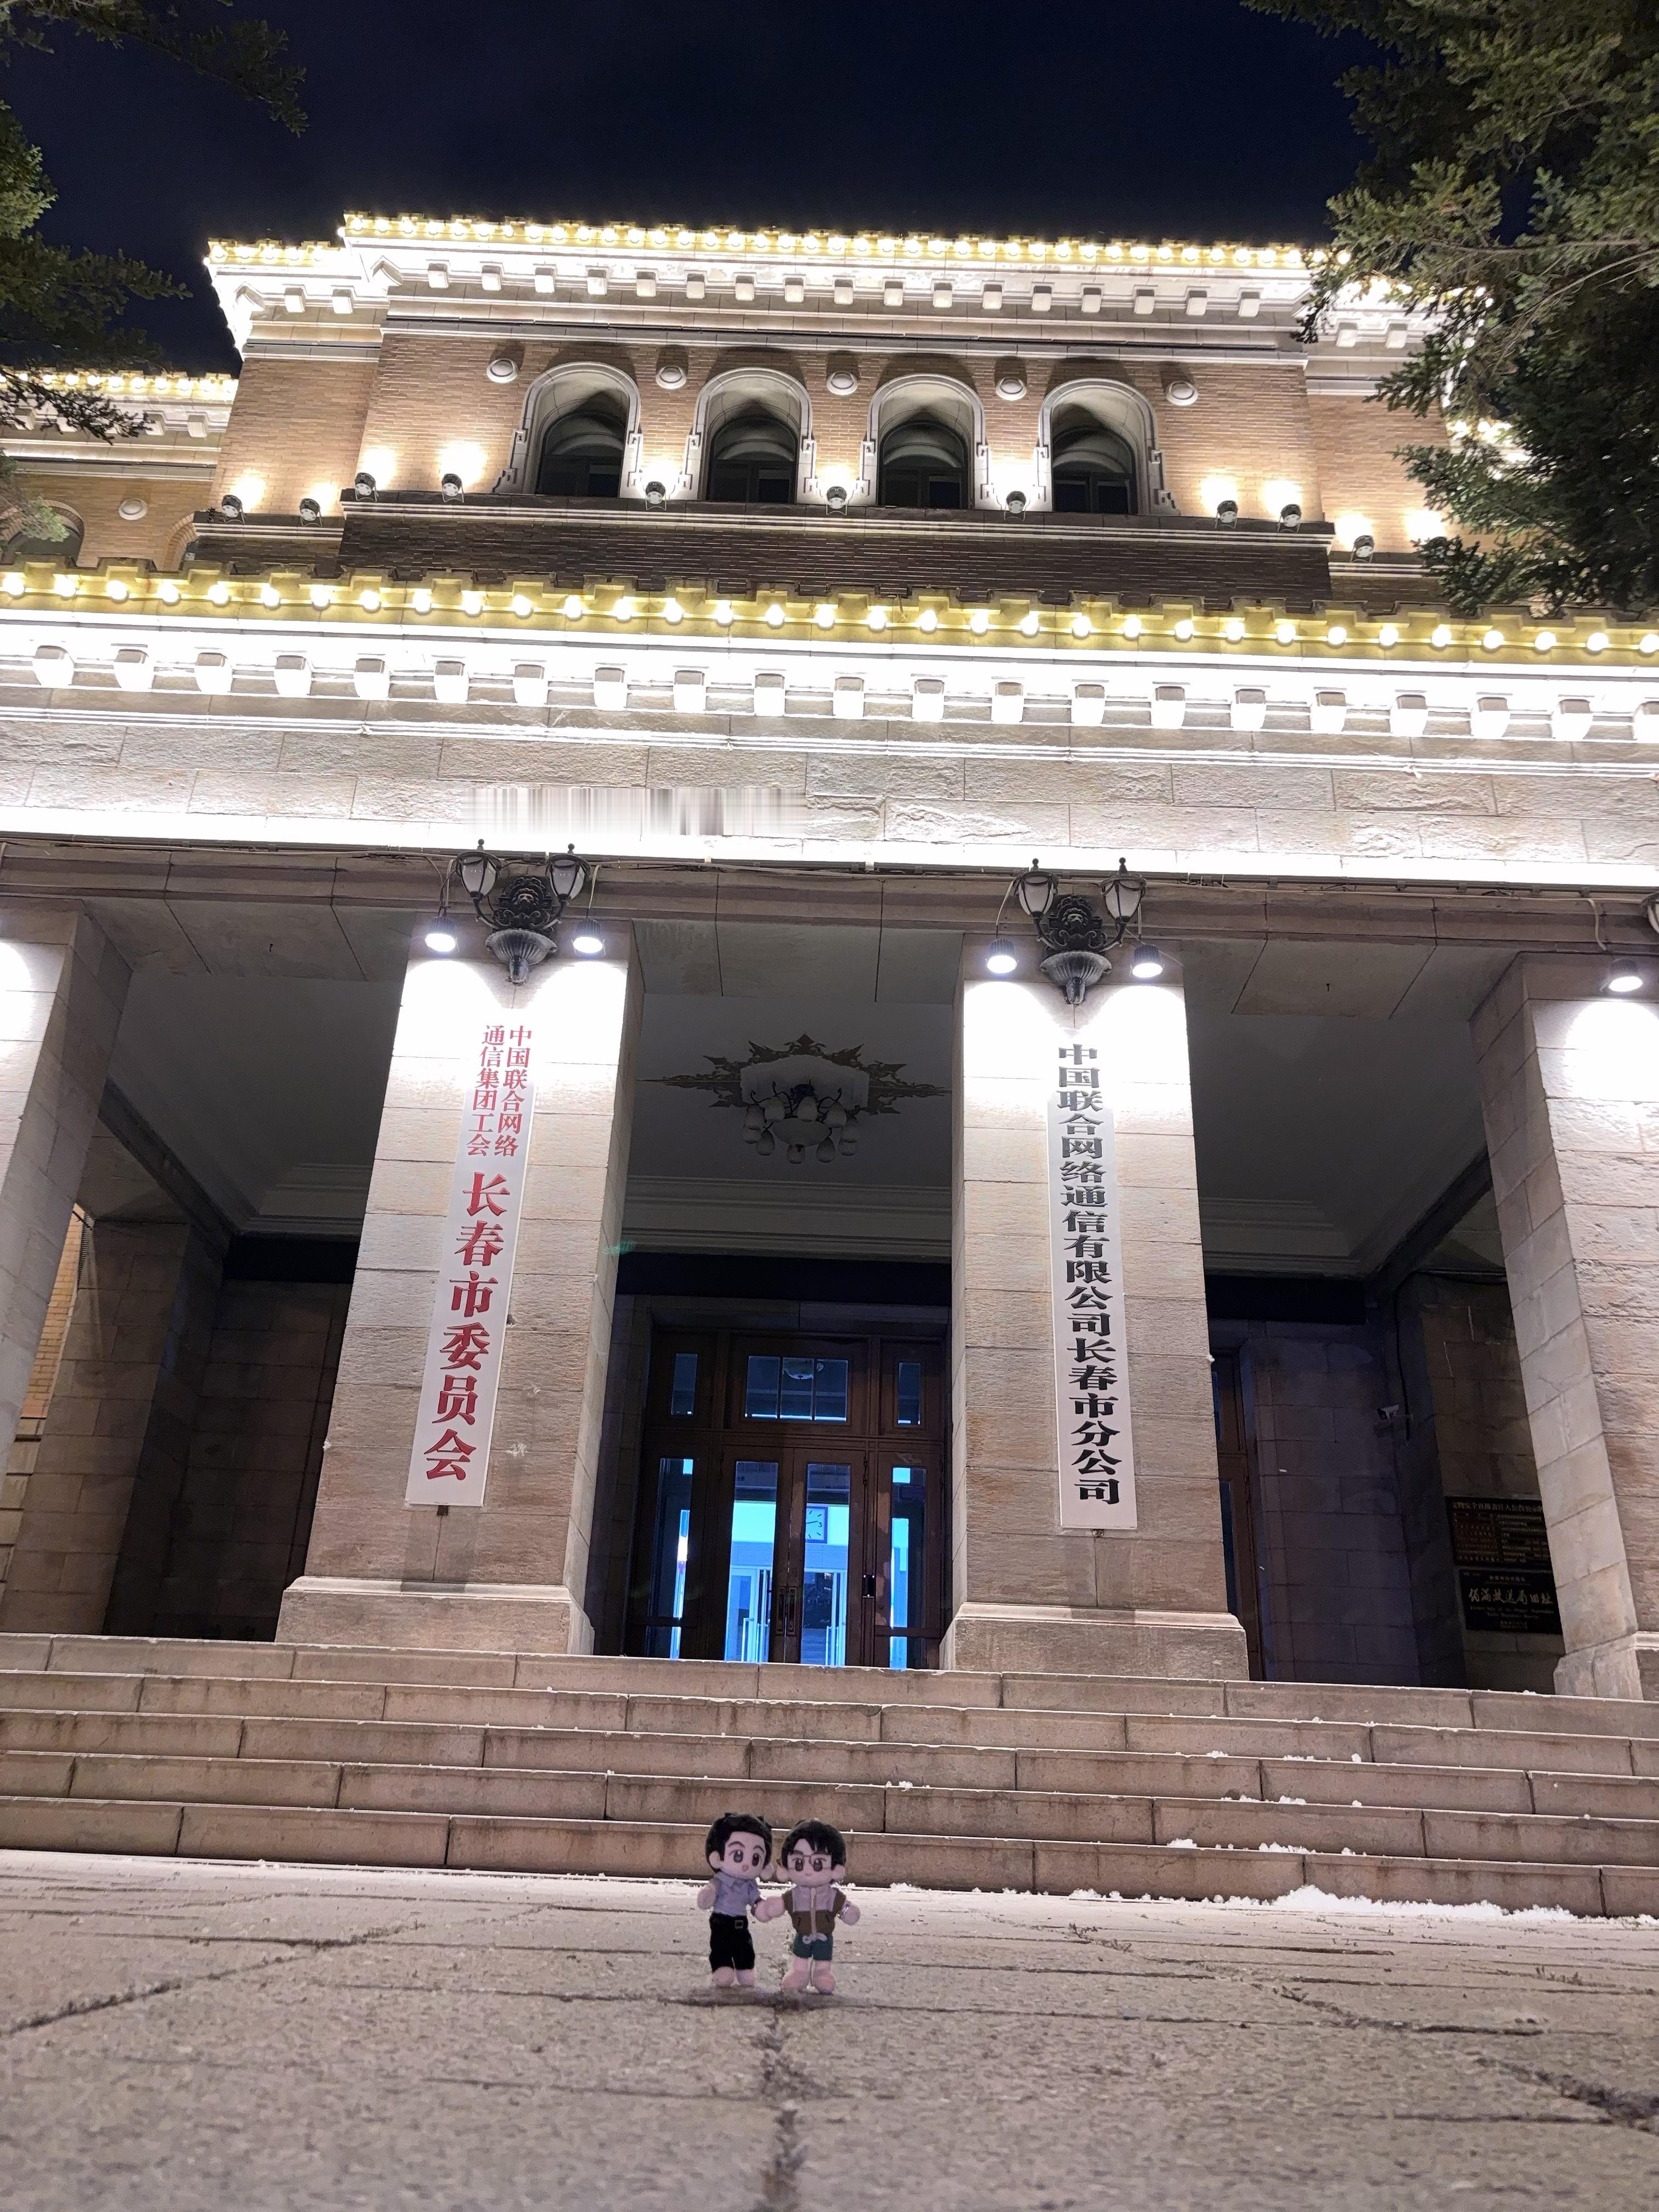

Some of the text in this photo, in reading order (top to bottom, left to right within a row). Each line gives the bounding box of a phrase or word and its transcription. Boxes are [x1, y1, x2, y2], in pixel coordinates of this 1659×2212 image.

[466, 1024, 506, 1157] 通信集团工会
[494, 1025, 532, 1157] 中国联合网络
[424, 1171, 510, 1481] 长春市委员会
[1057, 1043, 1122, 1505] 中国联合网络通信有限公司长春市分公司
